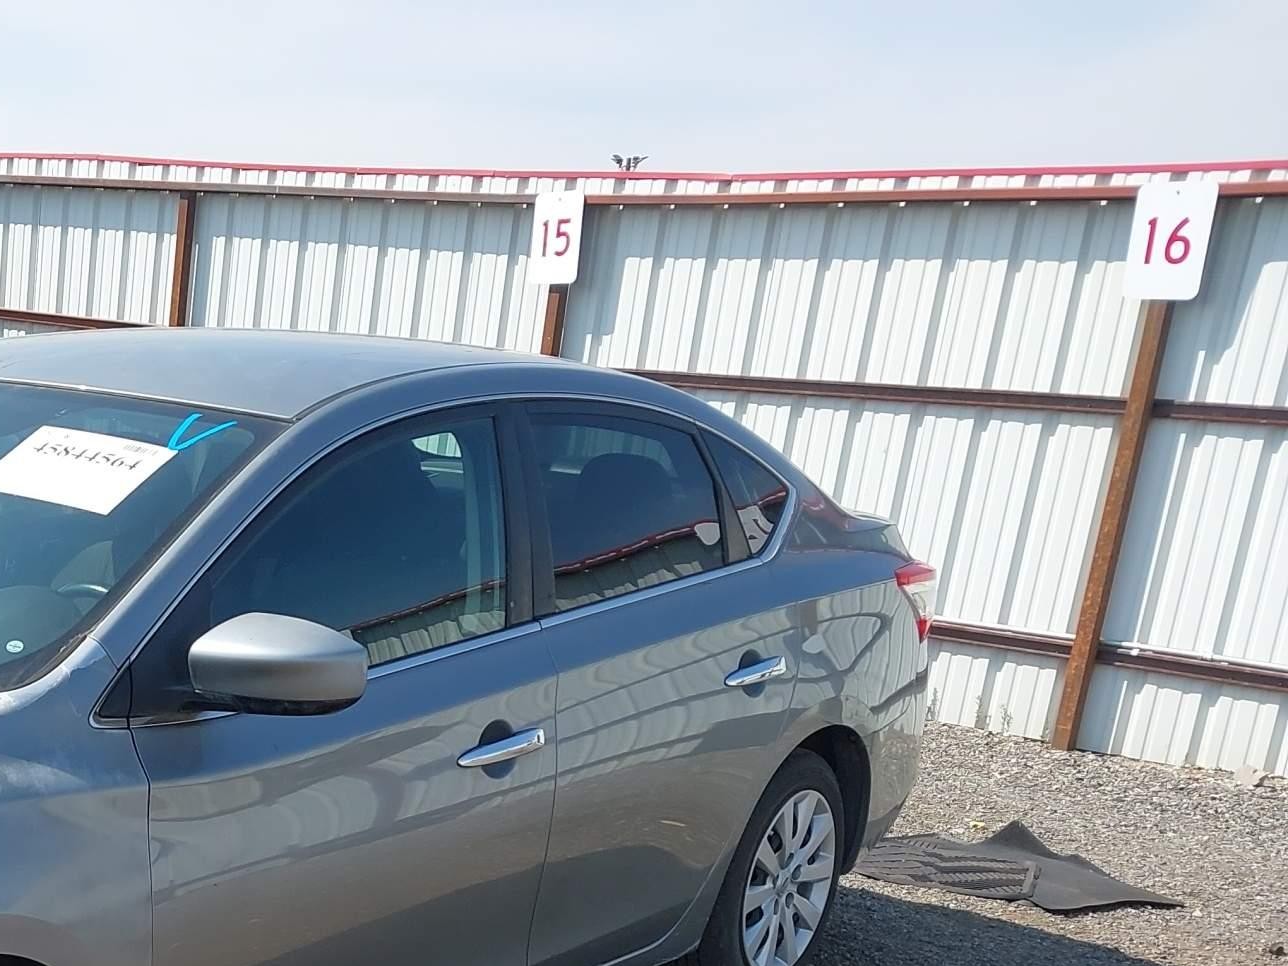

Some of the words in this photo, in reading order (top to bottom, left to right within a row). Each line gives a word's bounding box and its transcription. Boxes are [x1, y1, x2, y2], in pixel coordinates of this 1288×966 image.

[542, 218, 571, 257] 15
[1143, 217, 1191, 265] 16
[33, 442, 143, 471] 45844564
